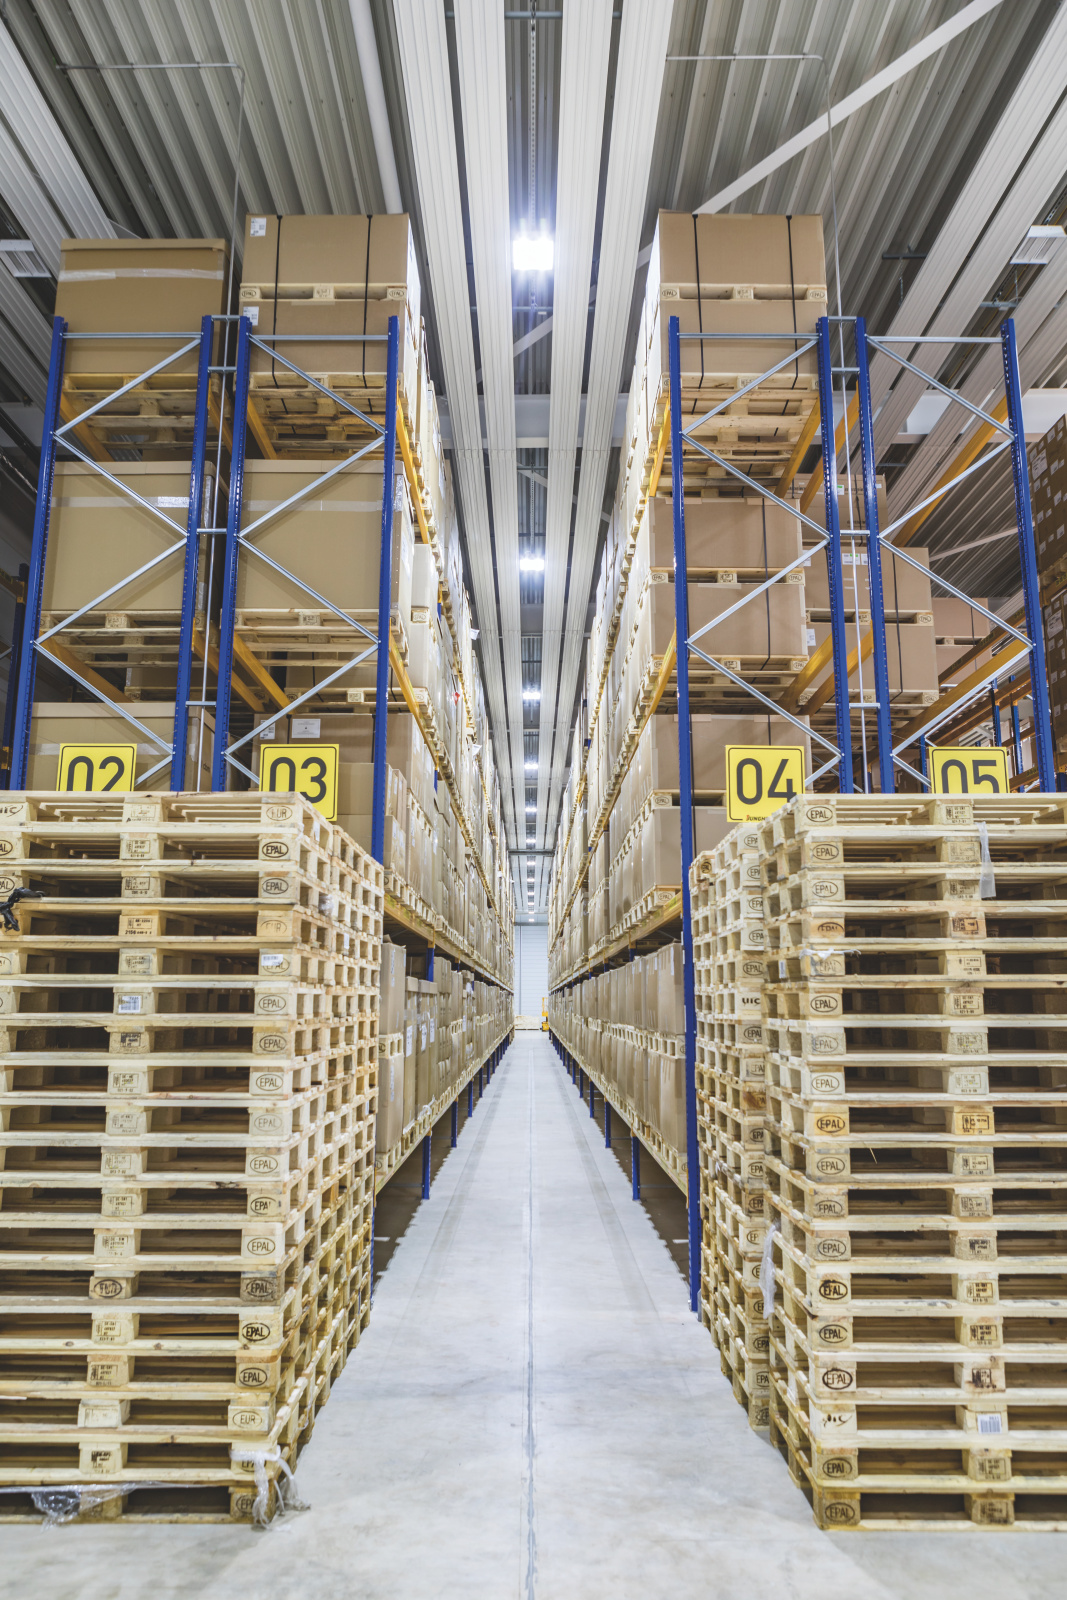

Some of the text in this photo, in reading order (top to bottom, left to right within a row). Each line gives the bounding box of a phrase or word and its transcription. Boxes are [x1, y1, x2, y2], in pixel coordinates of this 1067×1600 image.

[66, 756, 124, 791] 02
[941, 759, 999, 793] 05
[269, 757, 327, 803] 03
[736, 758, 797, 804] 04
[810, 809, 829, 819] EPAL
[265, 845, 285, 855] EPAL
[816, 848, 835, 857] EPAL
[265, 882, 285, 892] EPAL
[815, 885, 835, 894] EPAL
[262, 1000, 282, 1009] EPAL
[814, 1000, 834, 1009] EPAL
[263, 1039, 284, 1049] EPAL
[815, 1040, 834, 1049] EPAL
[259, 1078, 279, 1087] EPAL
[815, 1079, 836, 1089] EPAL
[258, 1118, 277, 1128] EPAL
[820, 1119, 842, 1129] EPAL
[253, 1160, 274, 1169] EPAL
[820, 1161, 842, 1171] EPAL
[254, 1201, 272, 1211] EPA
[251, 1242, 272, 1252] EPAL
[822, 1243, 844, 1254] EPAL
[250, 1283, 270, 1294] EPAL
[245, 1326, 266, 1338] EPAL
[824, 1328, 844, 1339] EPAL
[242, 1372, 263, 1383] EPAL
[756, 1375, 769, 1384] EPA
[827, 1373, 849, 1385] EPAL
[240, 1414, 257, 1425] EUR
[829, 1507, 850, 1518] EPAL
